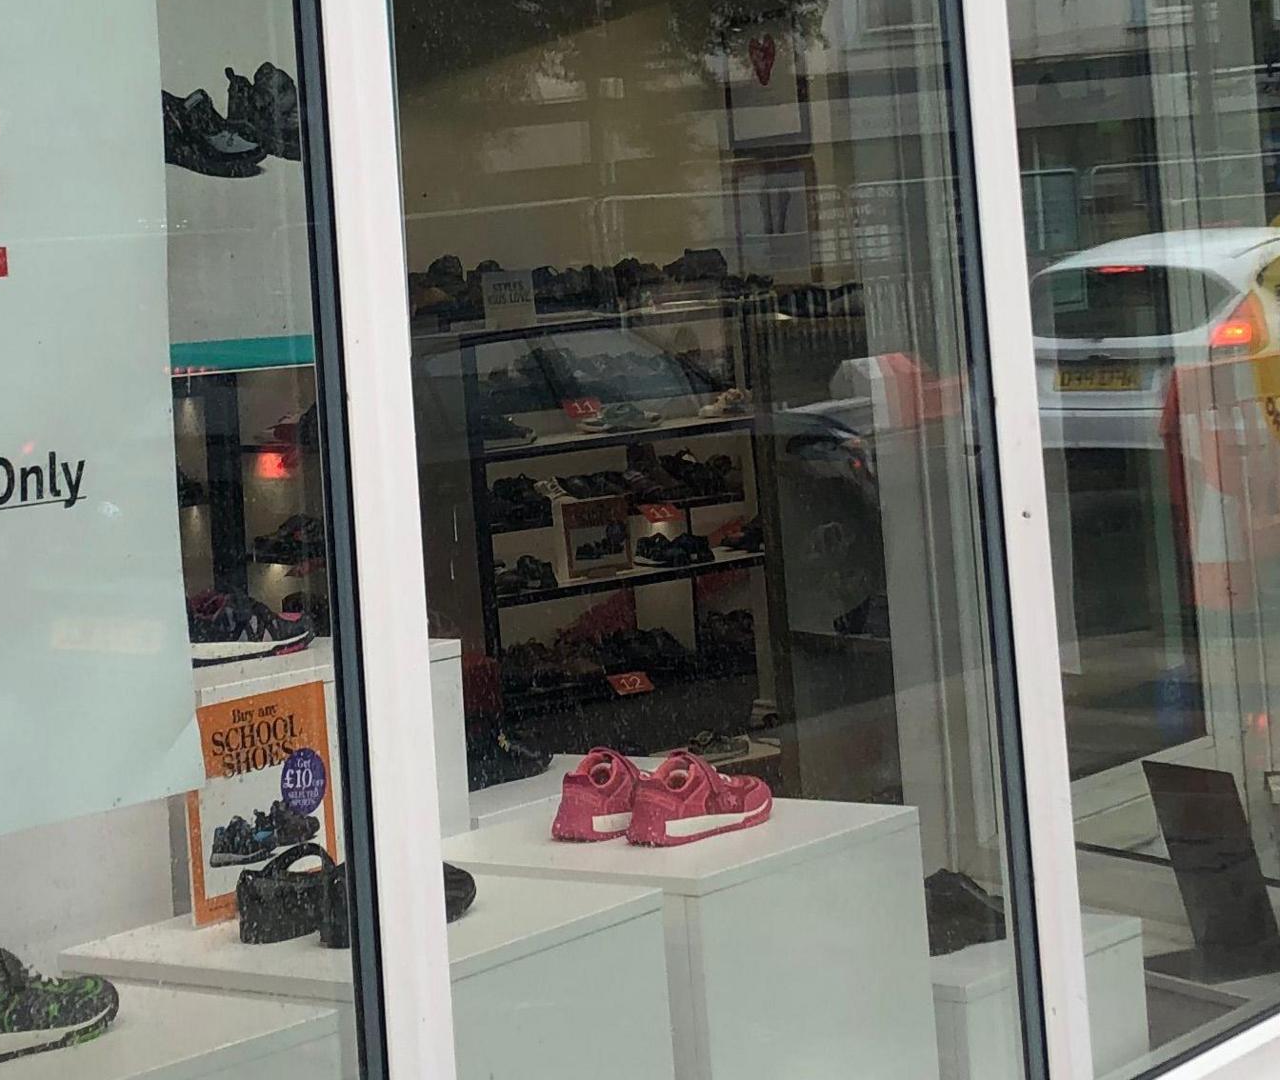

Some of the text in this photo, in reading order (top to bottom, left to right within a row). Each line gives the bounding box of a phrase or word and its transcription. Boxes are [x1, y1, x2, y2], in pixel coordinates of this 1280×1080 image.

[572, 400, 597, 414] 11
[650, 507, 674, 519] 11
[620, 676, 645, 690] 12
[232, 708, 255, 723] Buy
[211, 713, 302, 756] SCHOOL
[222, 740, 294, 778] SHOES
[283, 769, 312, 789] £10
